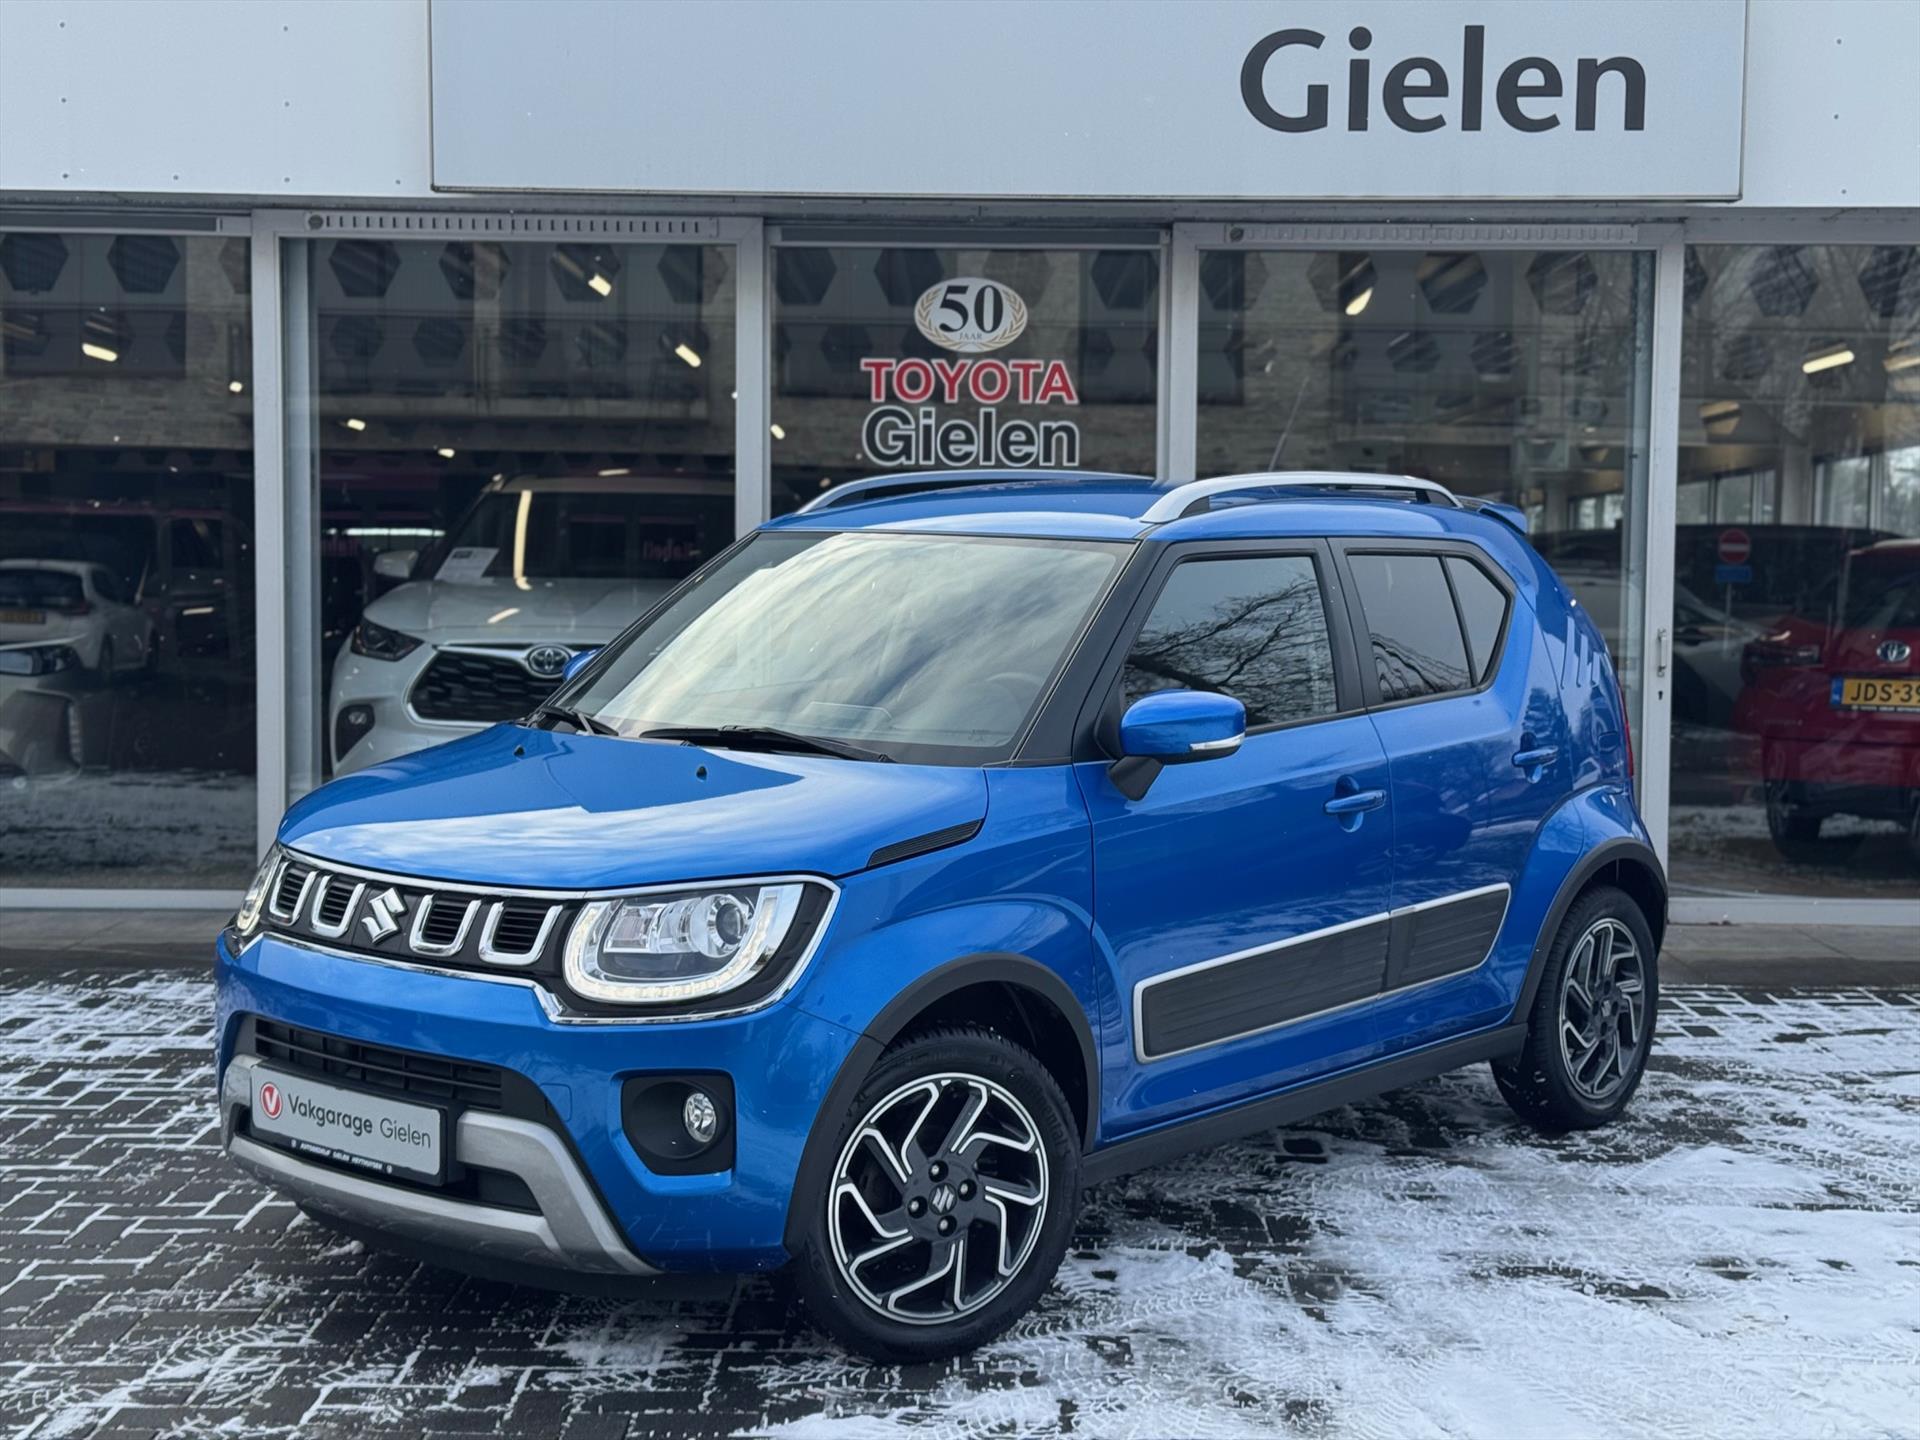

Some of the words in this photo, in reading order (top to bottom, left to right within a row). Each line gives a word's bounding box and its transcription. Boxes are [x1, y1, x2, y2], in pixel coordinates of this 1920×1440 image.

[1240, 24, 1646, 134] Gielen
[938, 284, 1004, 334] 50
[958, 332, 983, 341] JAAR
[860, 357, 1080, 405] TOYOTA
[861, 404, 1080, 467] Gielen
[287, 1092, 373, 1137] Vakgarage
[379, 1117, 431, 1149] Gielen
